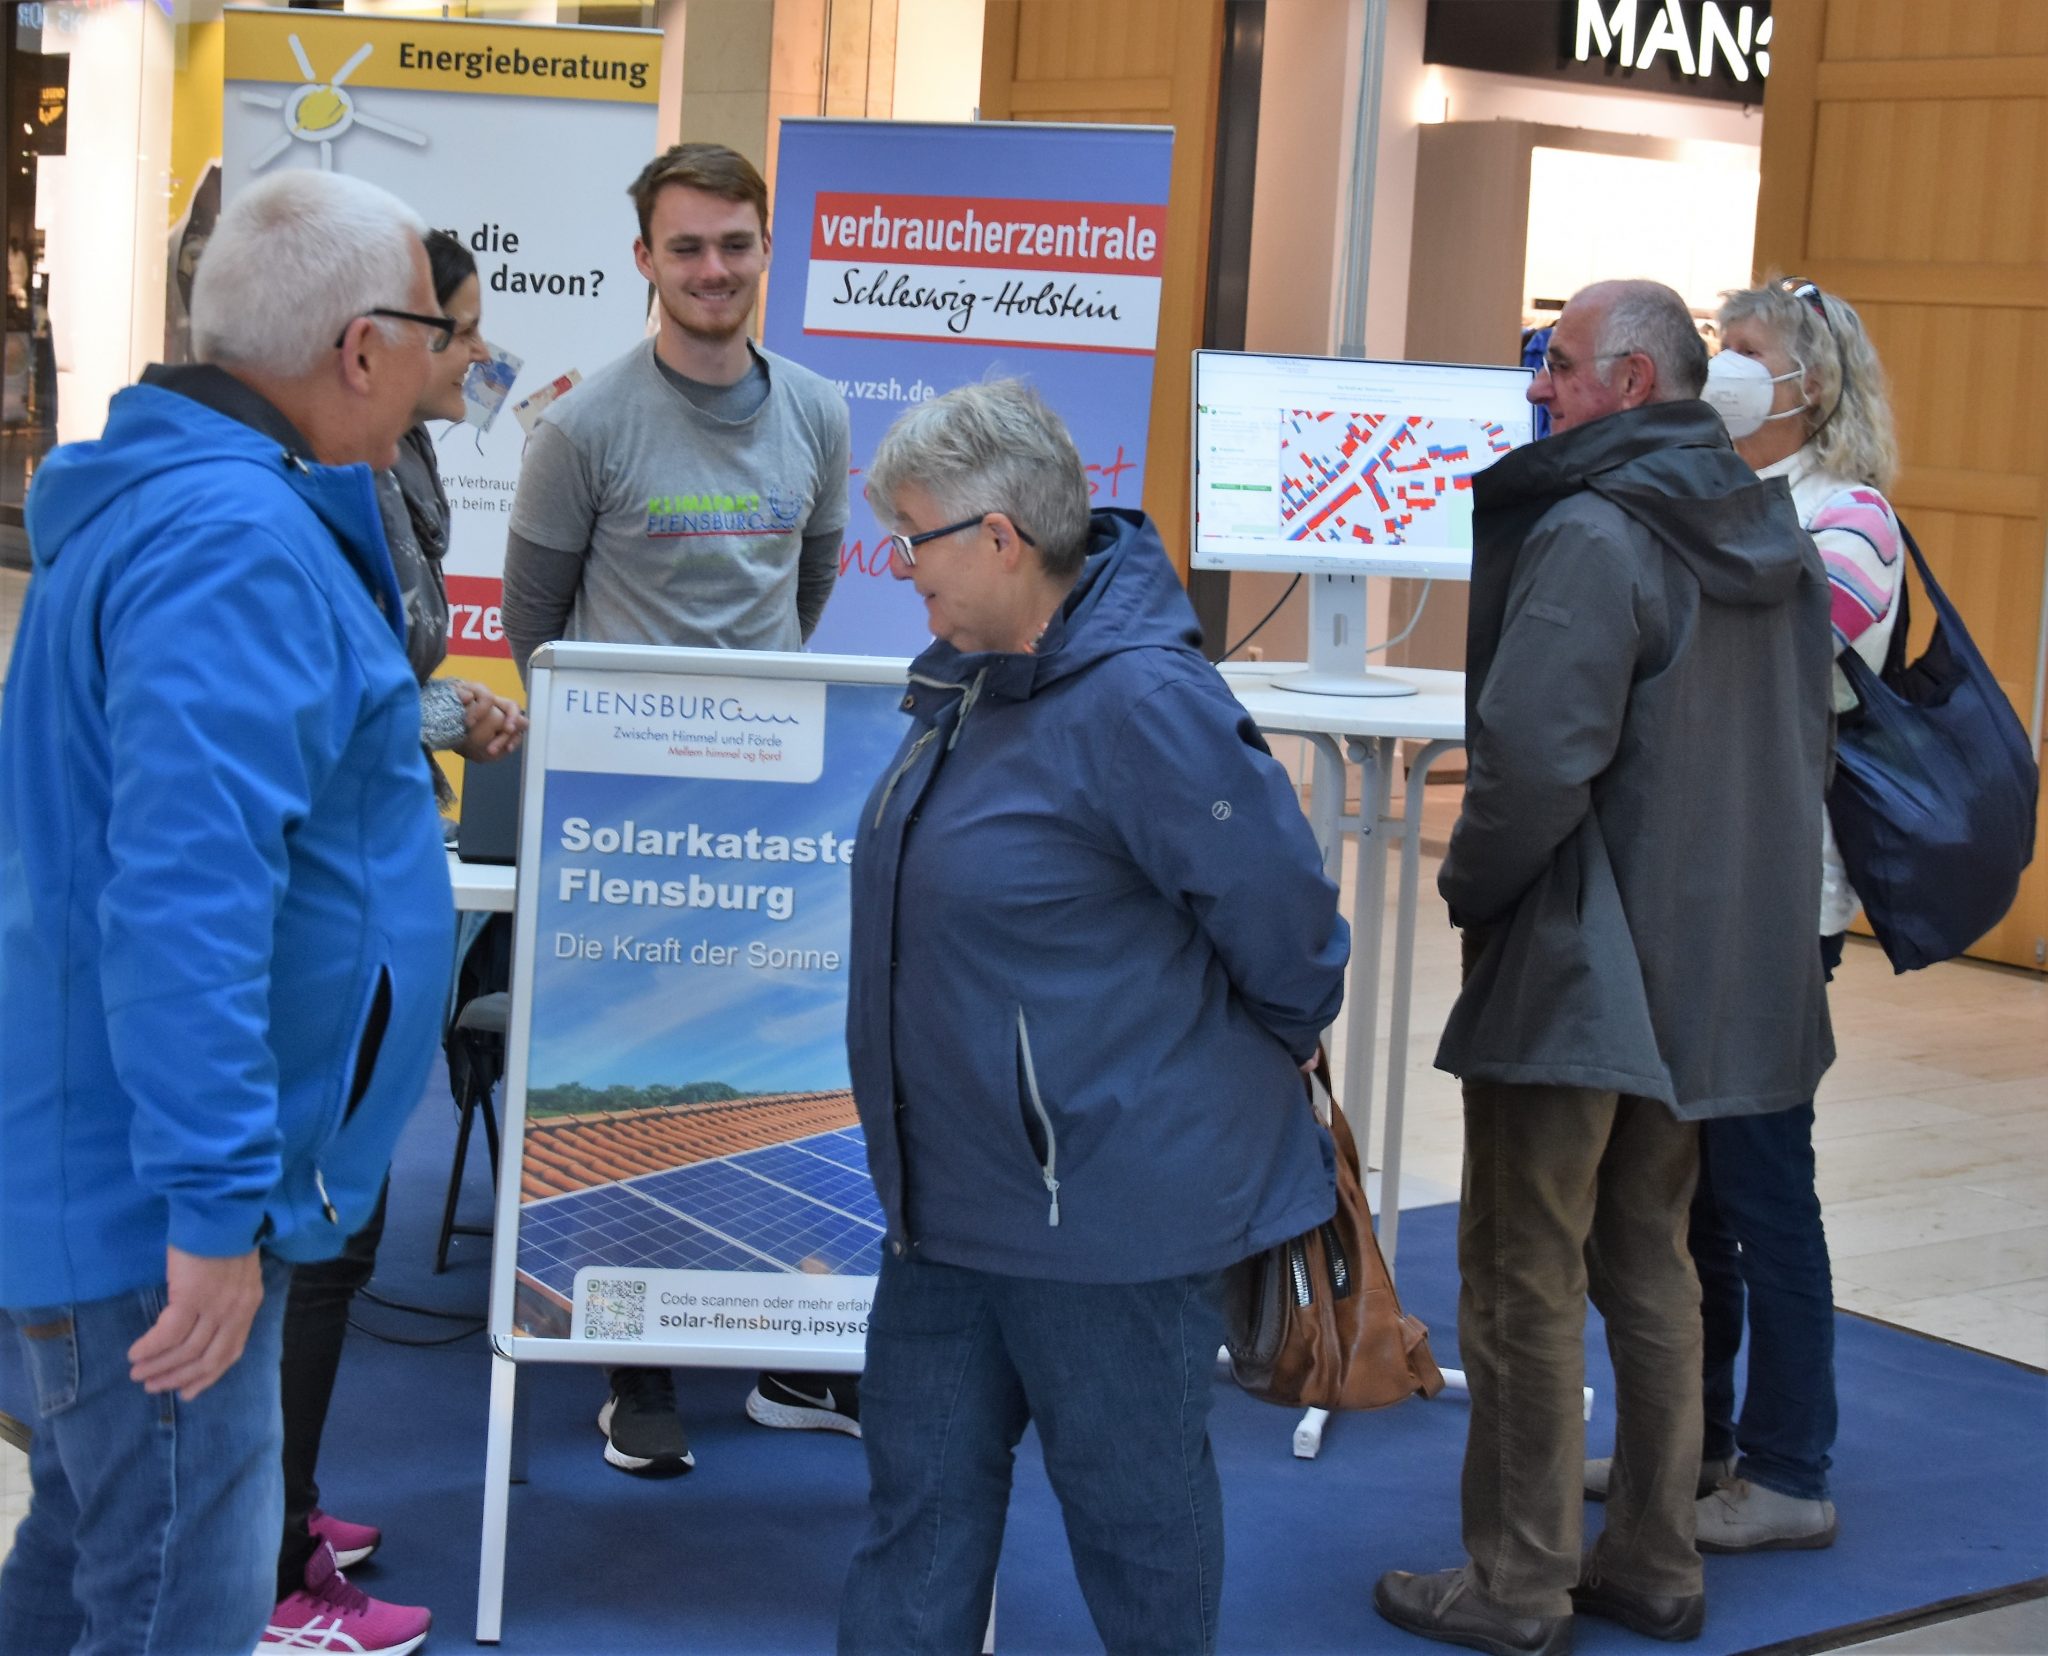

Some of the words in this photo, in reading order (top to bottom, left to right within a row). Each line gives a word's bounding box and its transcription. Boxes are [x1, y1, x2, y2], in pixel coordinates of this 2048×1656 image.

[399, 42, 649, 89] Energieberatung
[470, 223, 519, 253] die
[820, 205, 1157, 262] verbraucherzentrale
[490, 263, 605, 297] davon?
[833, 268, 1121, 333] Schleswig-Holstein
[462, 497, 495, 511] beim
[613, 726, 669, 742] Zwischen
[672, 730, 718, 744] Himmel
[721, 733, 744, 746] und
[748, 733, 782, 747] Förde
[705, 748, 740, 760] himmel
[743, 753, 756, 763] og
[758, 750, 782, 762] fjord
[558, 867, 795, 920] Flensburg
[554, 931, 603, 960] Die
[612, 935, 682, 964] Kraft
[690, 939, 738, 966] der
[747, 941, 841, 970] Sonne
[660, 1291, 697, 1305] Code
[701, 1294, 759, 1308] scannen
[763, 1296, 794, 1310] oder
[798, 1298, 833, 1311] mehr
